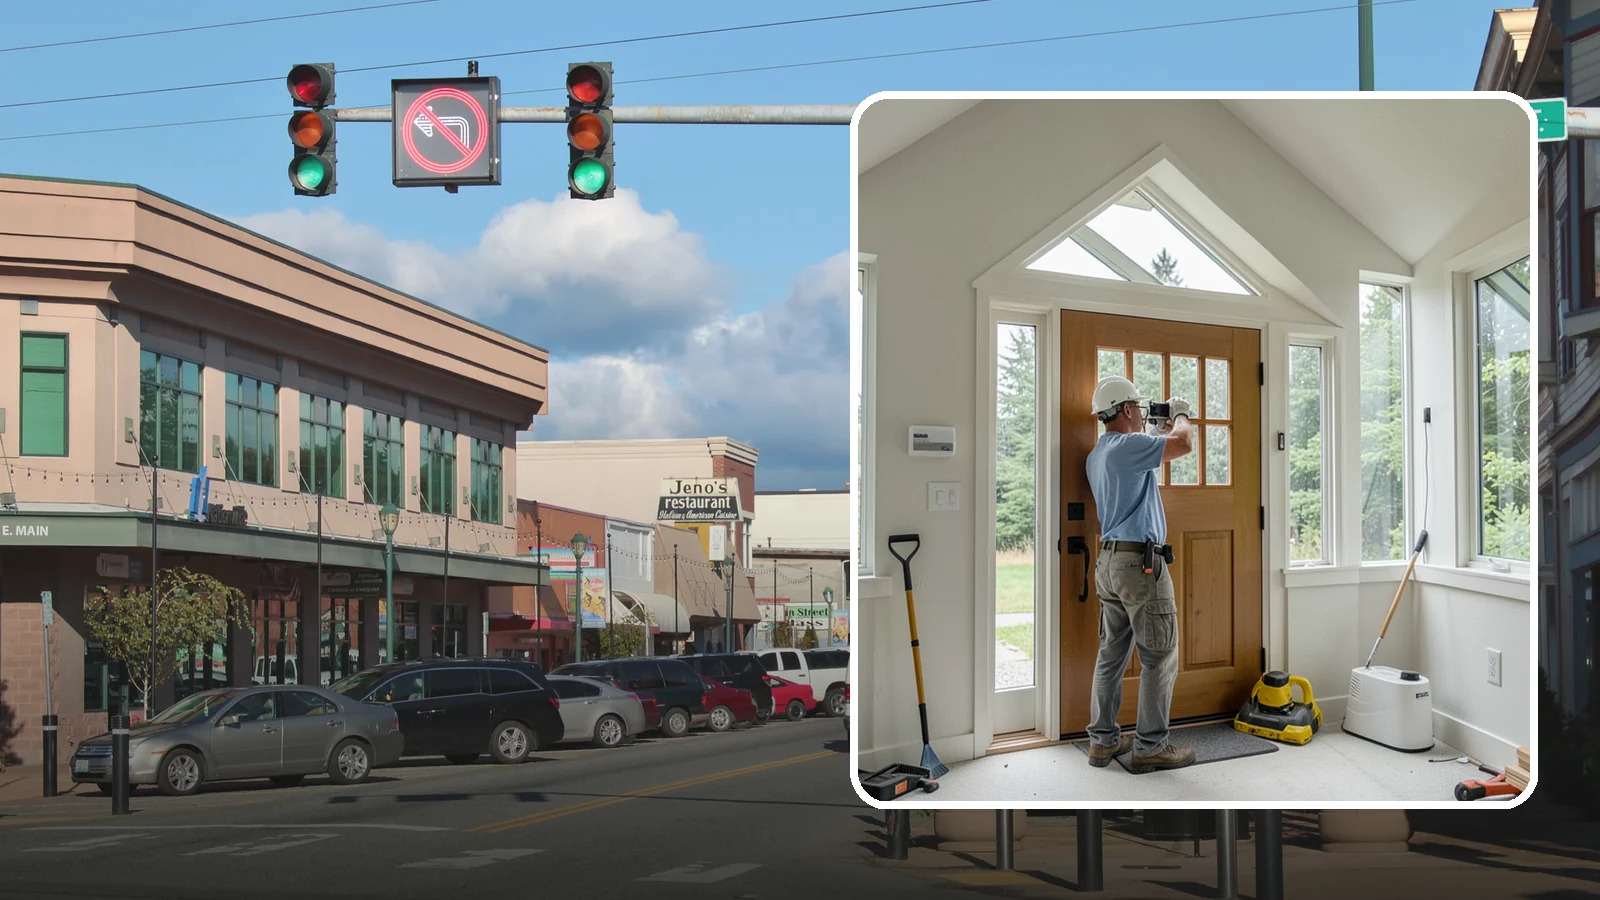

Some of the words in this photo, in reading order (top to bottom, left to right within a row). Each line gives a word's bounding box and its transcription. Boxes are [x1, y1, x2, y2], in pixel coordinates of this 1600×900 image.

[670, 480, 728, 494] Jeno's
[665, 496, 731, 509] restaurant
[658, 510, 681, 519] Italian
[686, 509, 714, 519] American
[715, 509, 737, 519] Cuisine
[2, 525, 13, 536] E.
[15, 525, 49, 536] MAIN
[797, 608, 828, 617] Street
